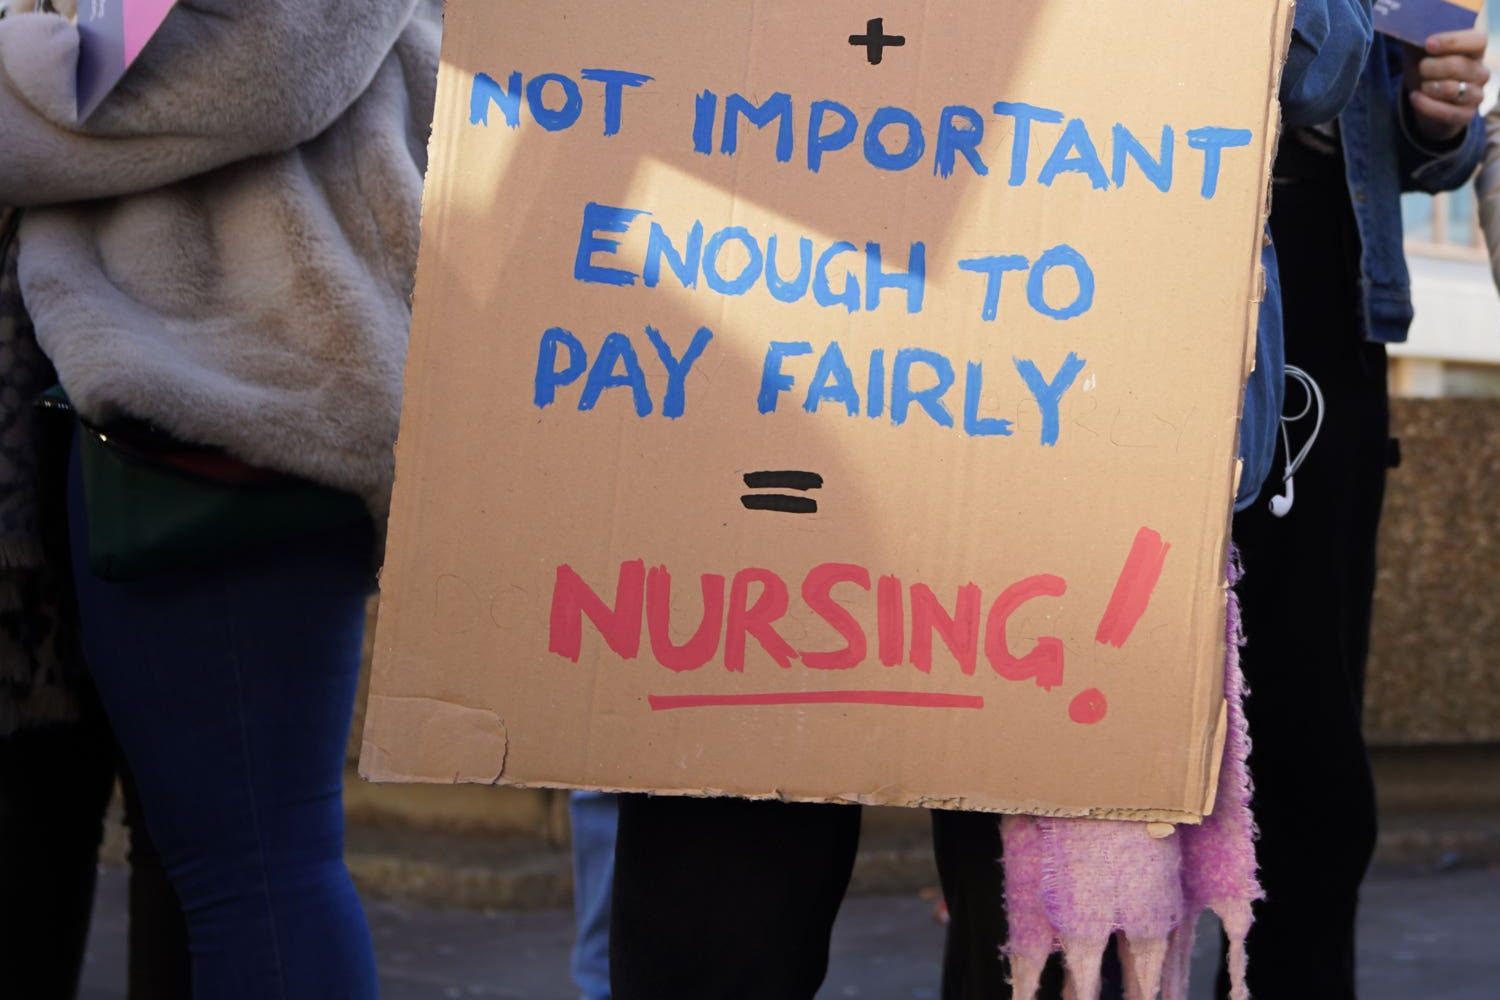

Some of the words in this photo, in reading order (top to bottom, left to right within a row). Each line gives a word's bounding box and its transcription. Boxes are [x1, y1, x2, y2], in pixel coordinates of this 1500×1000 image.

[470, 69, 654, 136] NOT
[693, 90, 1251, 198] IMPORTANT
[574, 203, 925, 313] ENOUGH
[959, 245, 1094, 320] TO
[534, 327, 712, 419] PAY
[758, 342, 1086, 446] FAIRLY
[549, 527, 1171, 724] NURSING!
